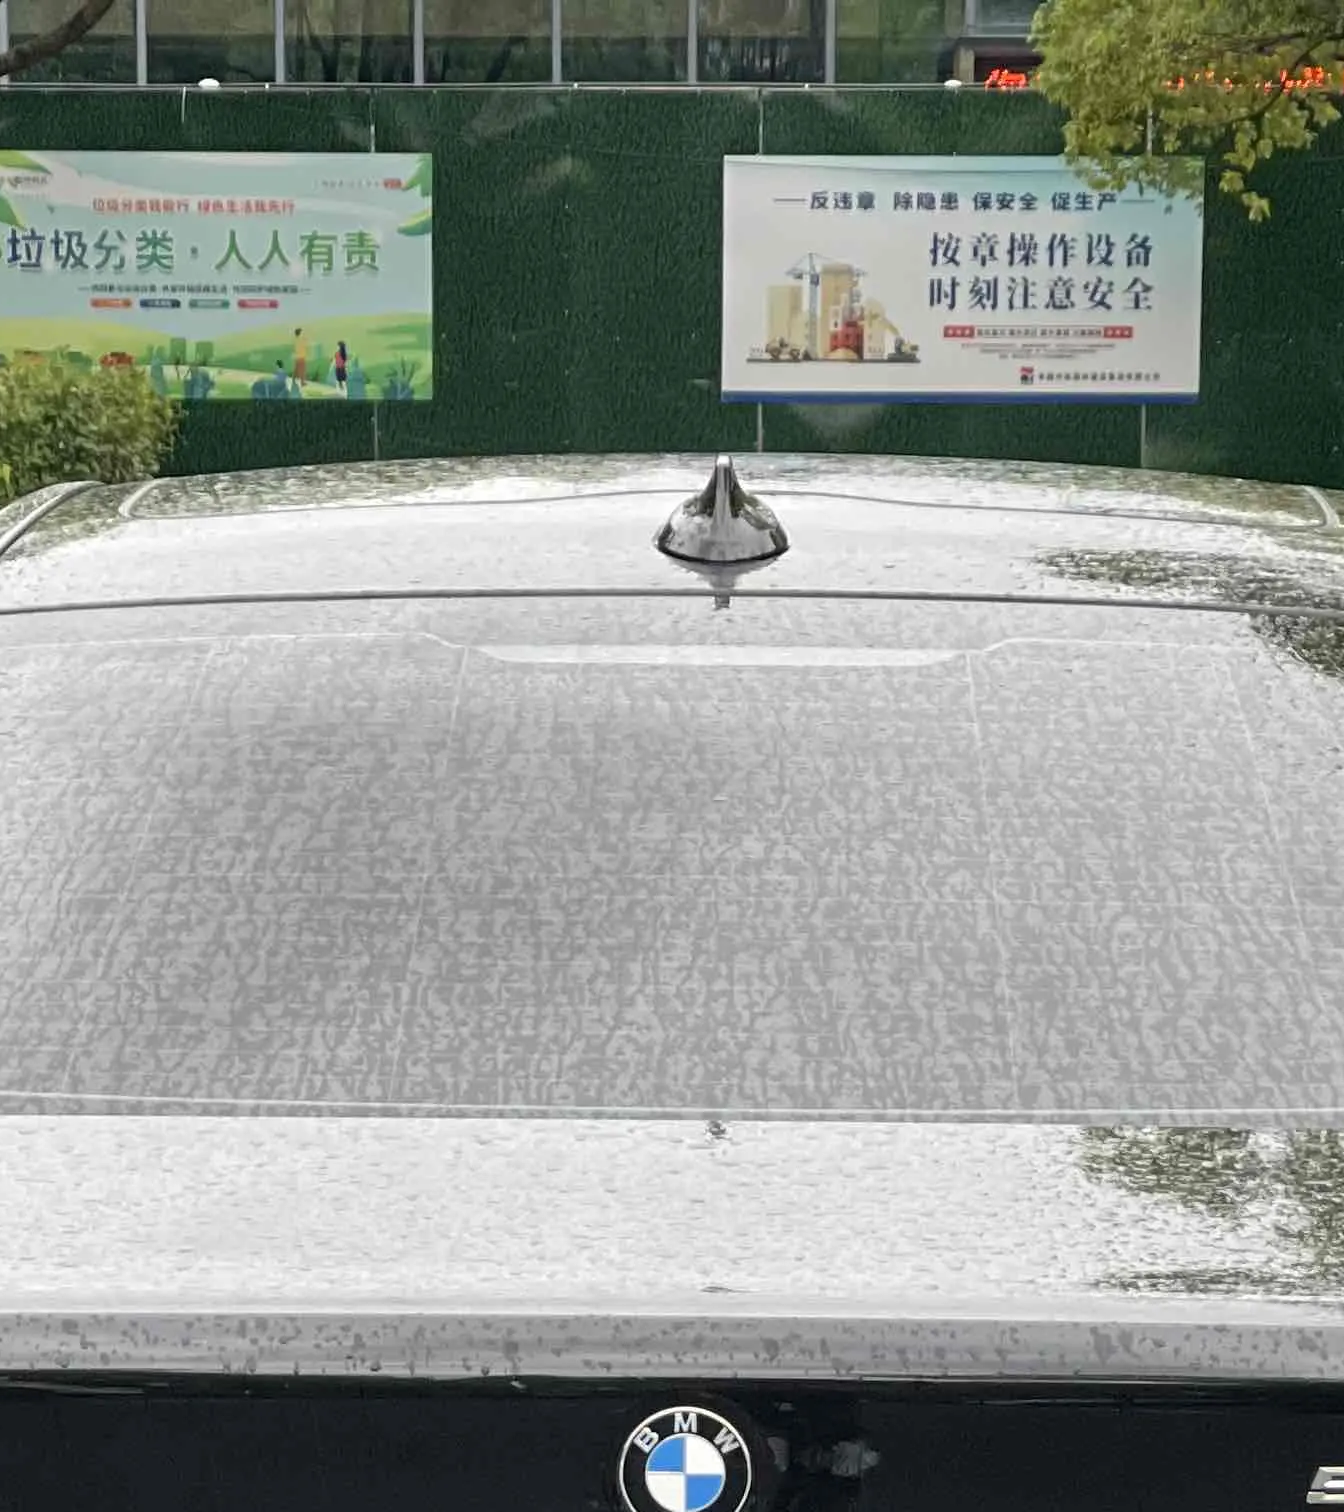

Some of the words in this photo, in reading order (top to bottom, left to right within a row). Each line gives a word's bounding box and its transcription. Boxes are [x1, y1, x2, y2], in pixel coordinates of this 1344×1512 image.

[809, 190, 876, 211] 反违章
[893, 190, 959, 212] 除隐患
[972, 190, 1038, 212] 保安全
[1051, 190, 1118, 212] 促生产
[929, 232, 1154, 269] 按章操作设备
[929, 276, 1154, 312] 时刻注意安全
[633, 1412, 739, 1454] BMW
